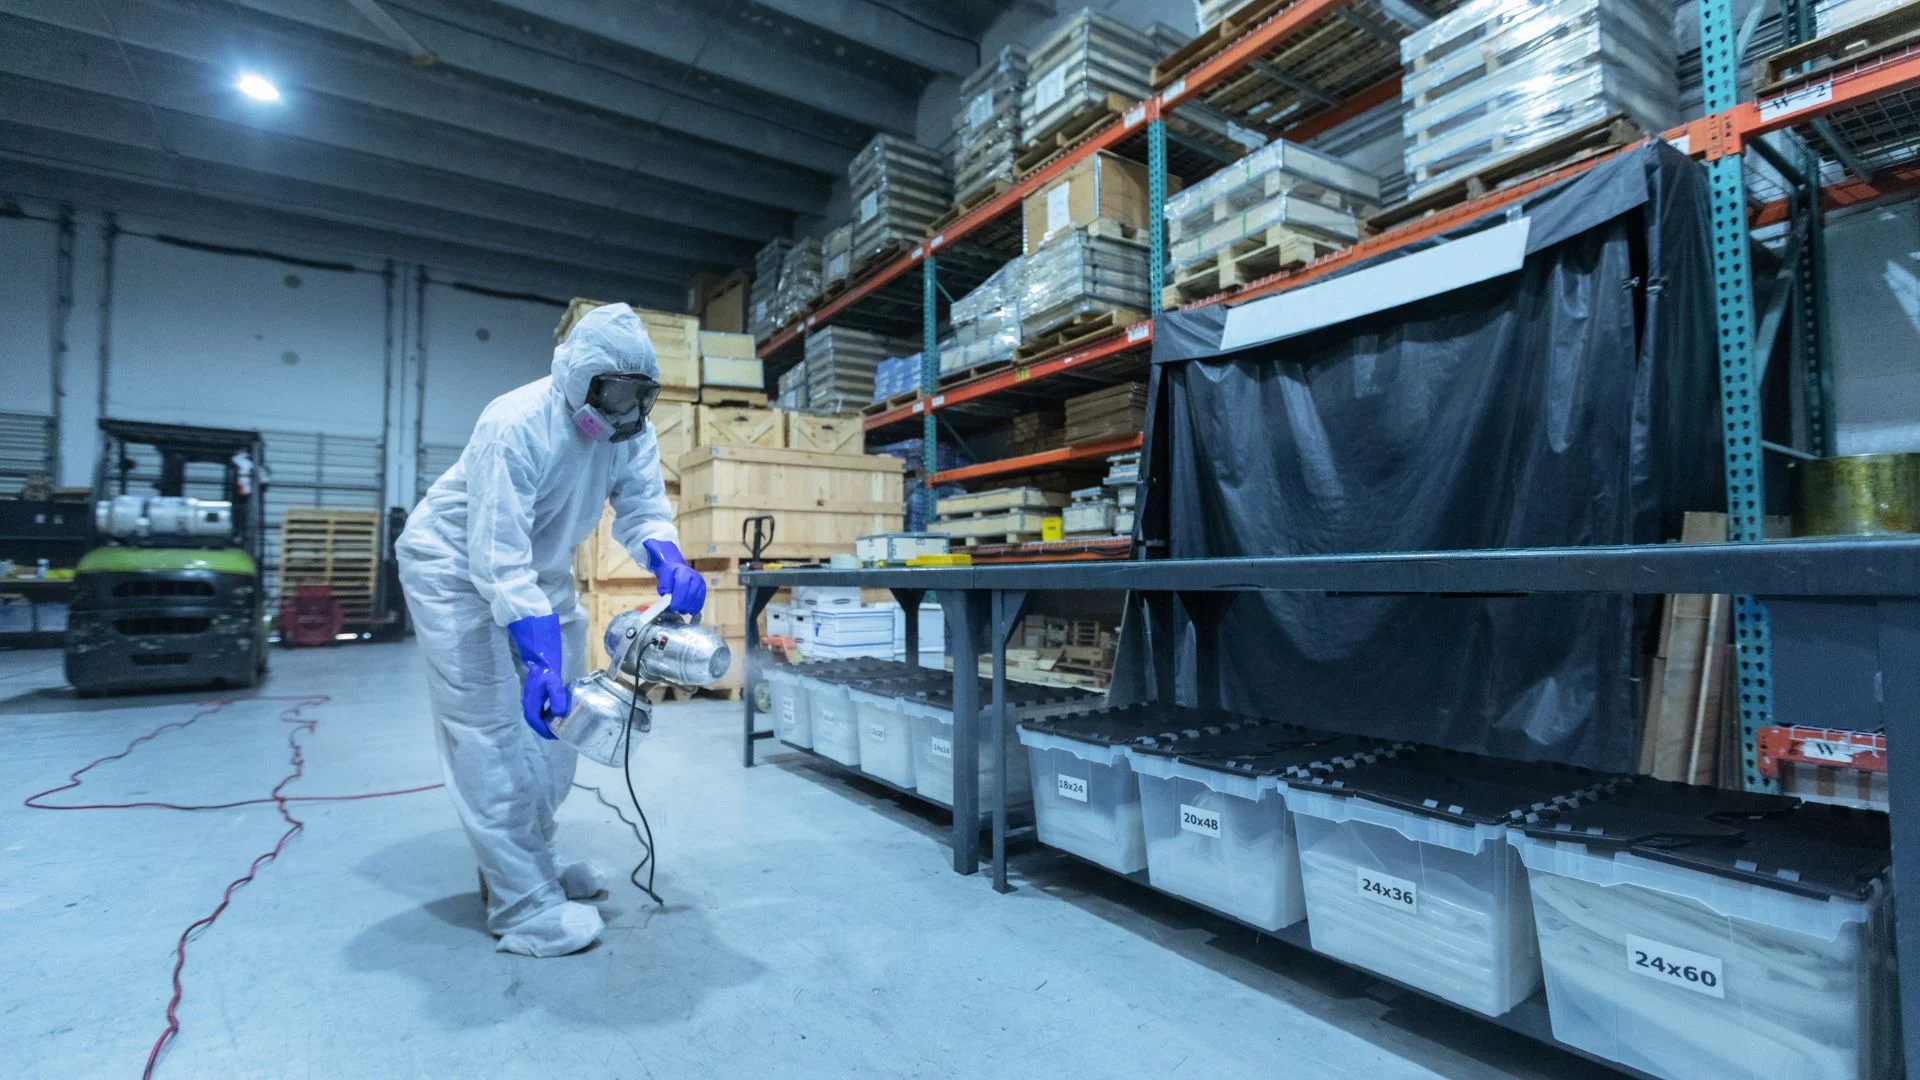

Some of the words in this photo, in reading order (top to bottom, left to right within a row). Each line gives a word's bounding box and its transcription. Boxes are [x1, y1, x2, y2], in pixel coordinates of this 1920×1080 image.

[1059, 779, 1084, 793] 18x24
[1184, 812, 1218, 831] 20x48
[1362, 878, 1413, 905] 24x36
[1635, 950, 1717, 987] 24x60
